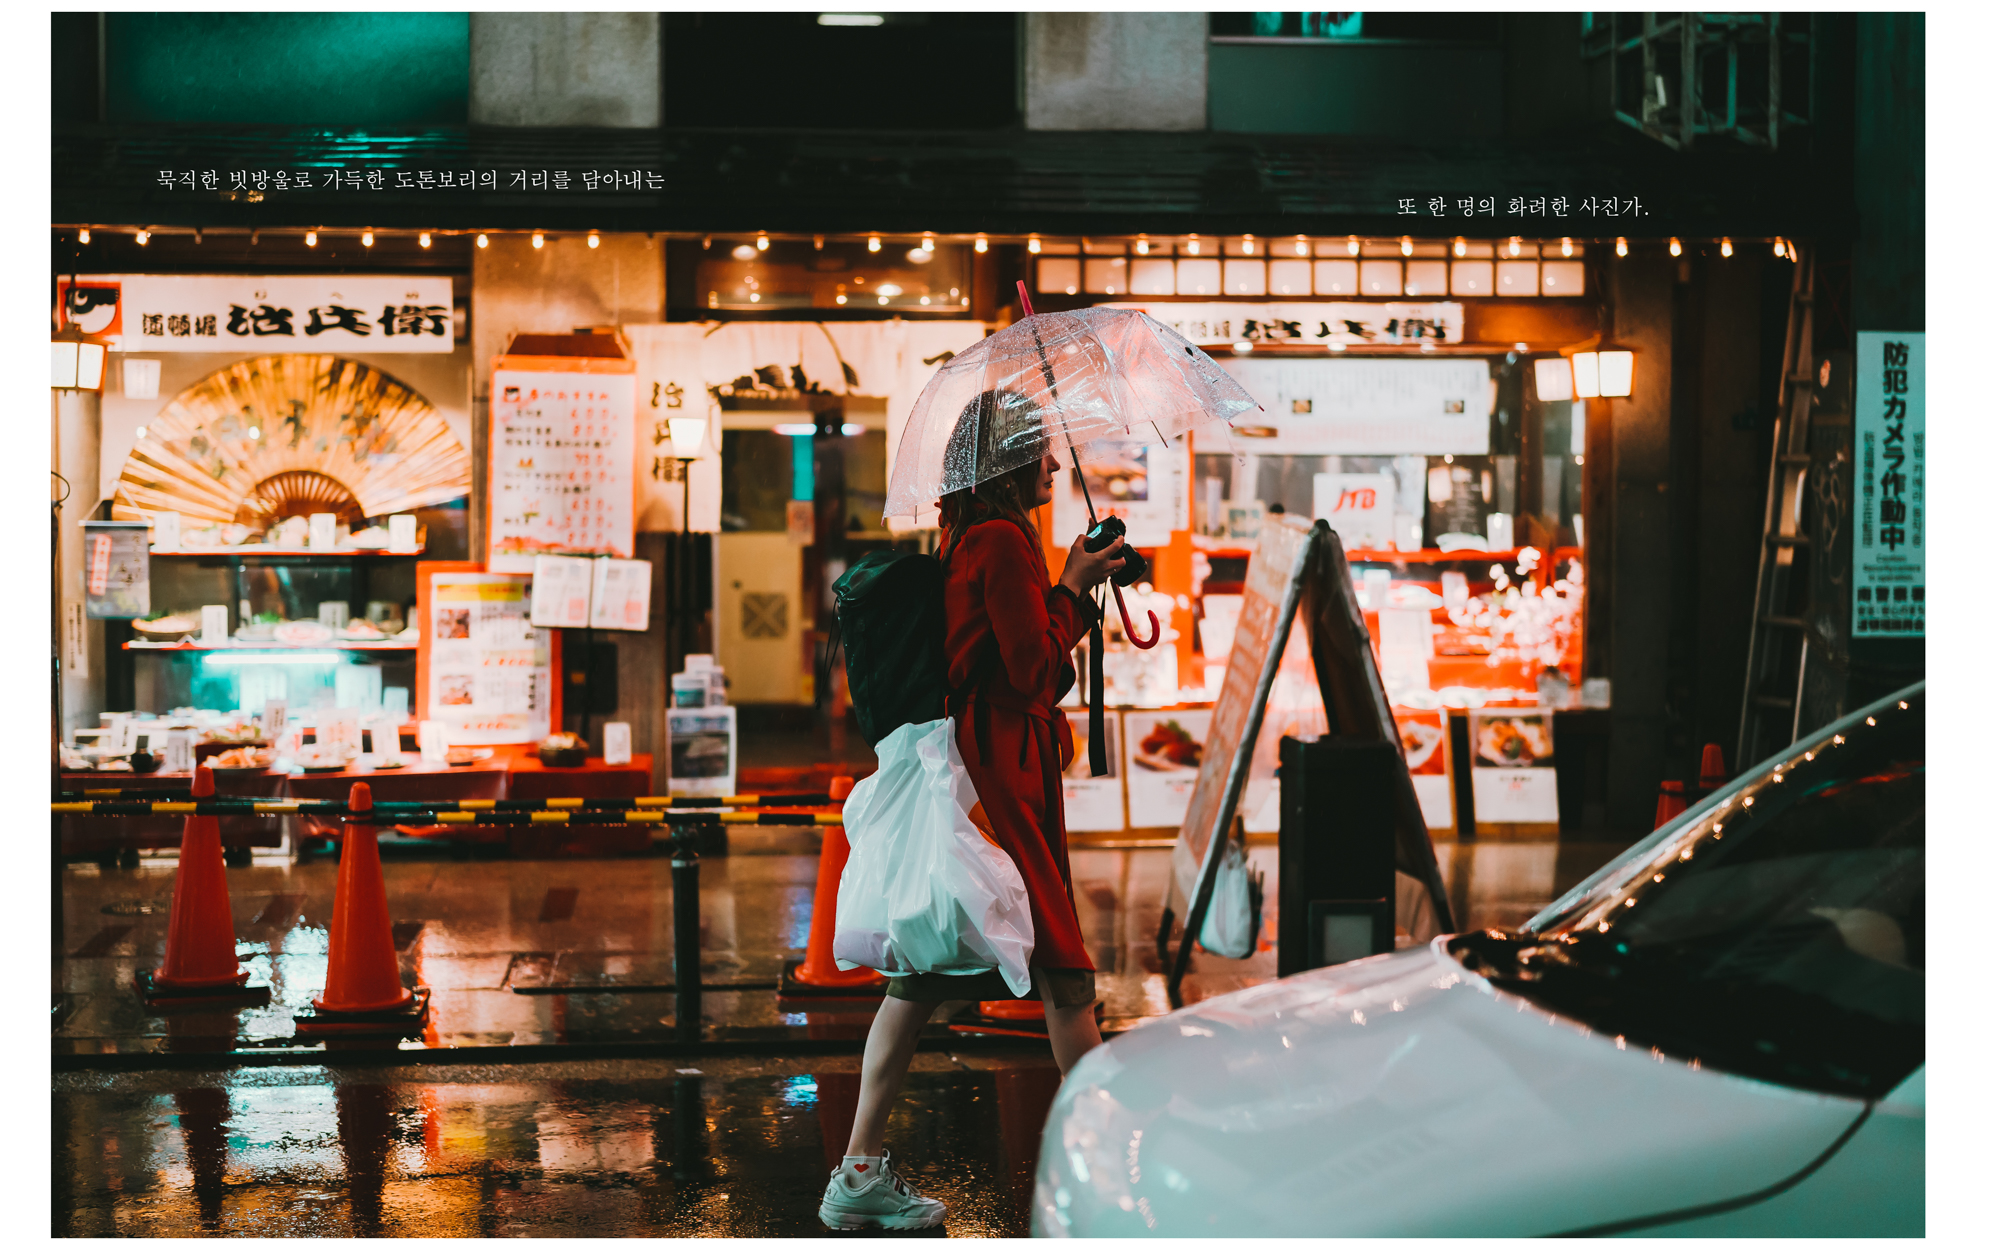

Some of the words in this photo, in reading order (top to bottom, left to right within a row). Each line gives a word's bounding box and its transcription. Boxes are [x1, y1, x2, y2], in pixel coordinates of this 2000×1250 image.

[1332, 487, 1377, 513] JTB
[1880, 341, 1908, 550] 防犯カメラ作動中
